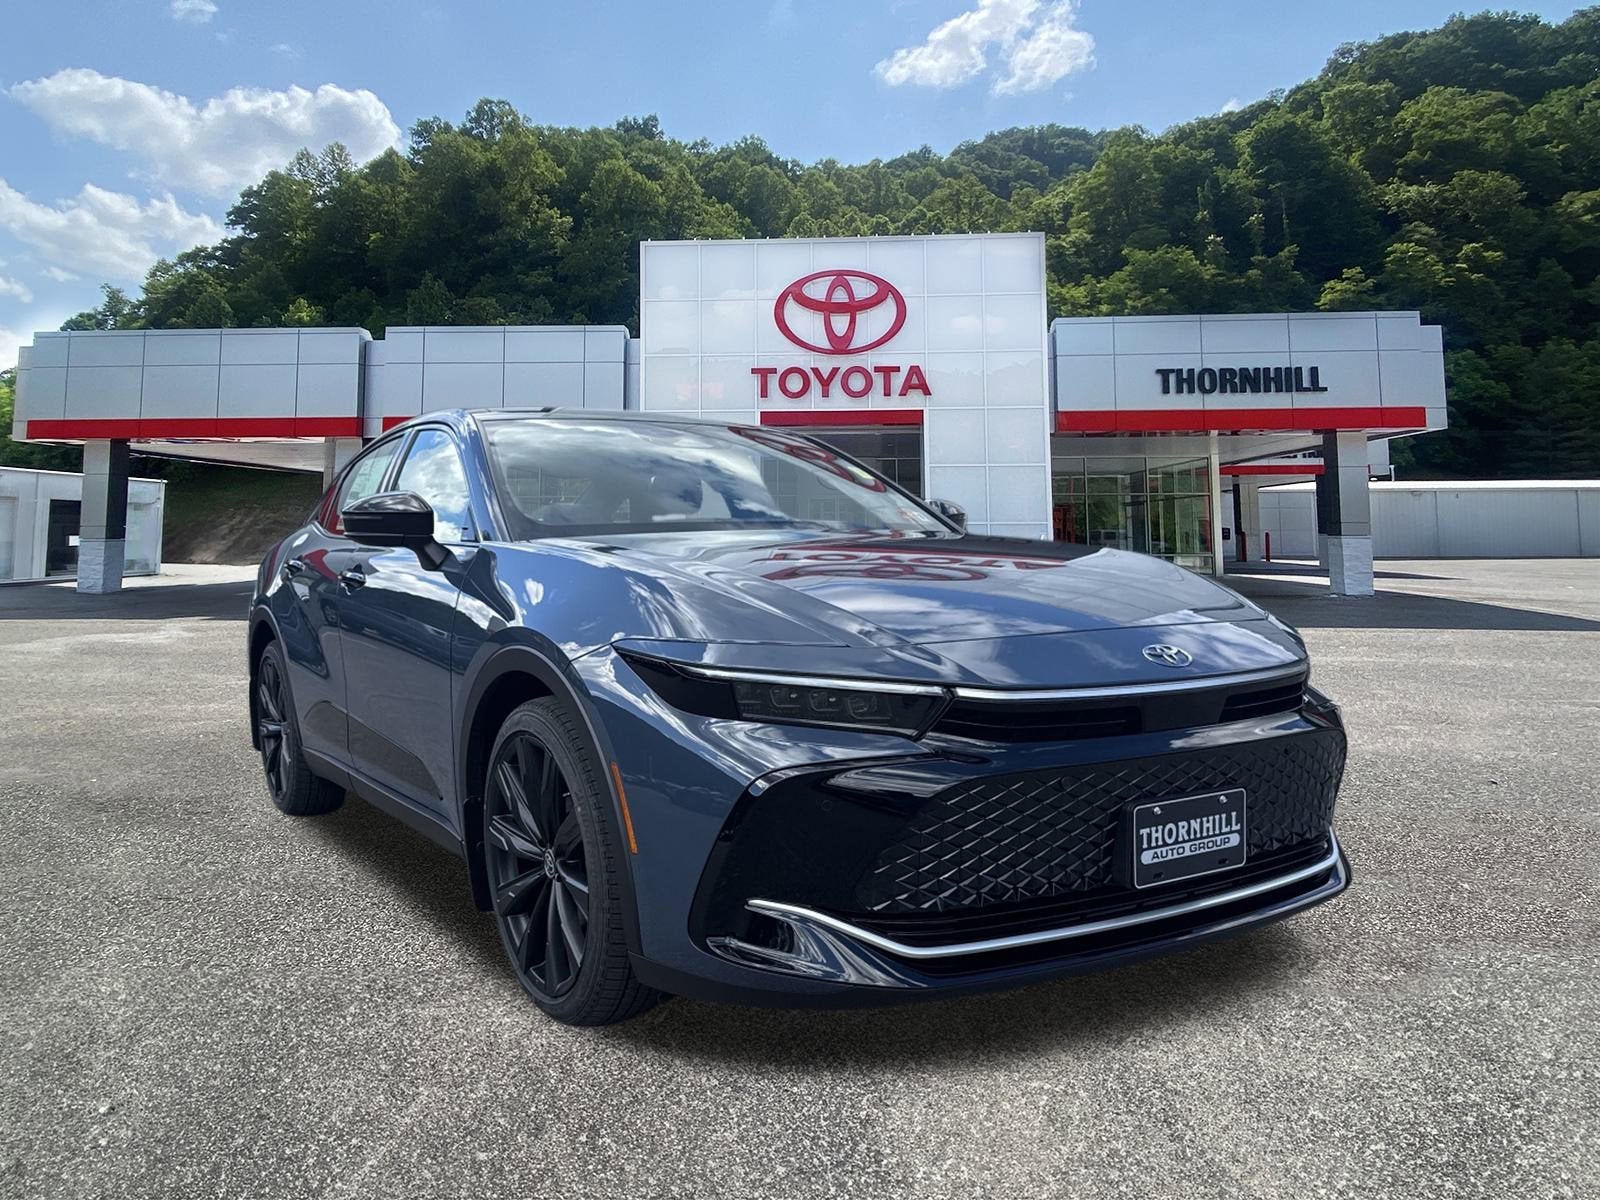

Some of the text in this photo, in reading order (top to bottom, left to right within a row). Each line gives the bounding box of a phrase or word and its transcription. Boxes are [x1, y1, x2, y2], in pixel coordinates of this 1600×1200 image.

[751, 365, 932, 399] TOYOTA
[1155, 366, 1328, 394] THORNHILL
[1140, 811, 1241, 849] THORNHILL
[1151, 836, 1231, 862] AUTO GROUP
